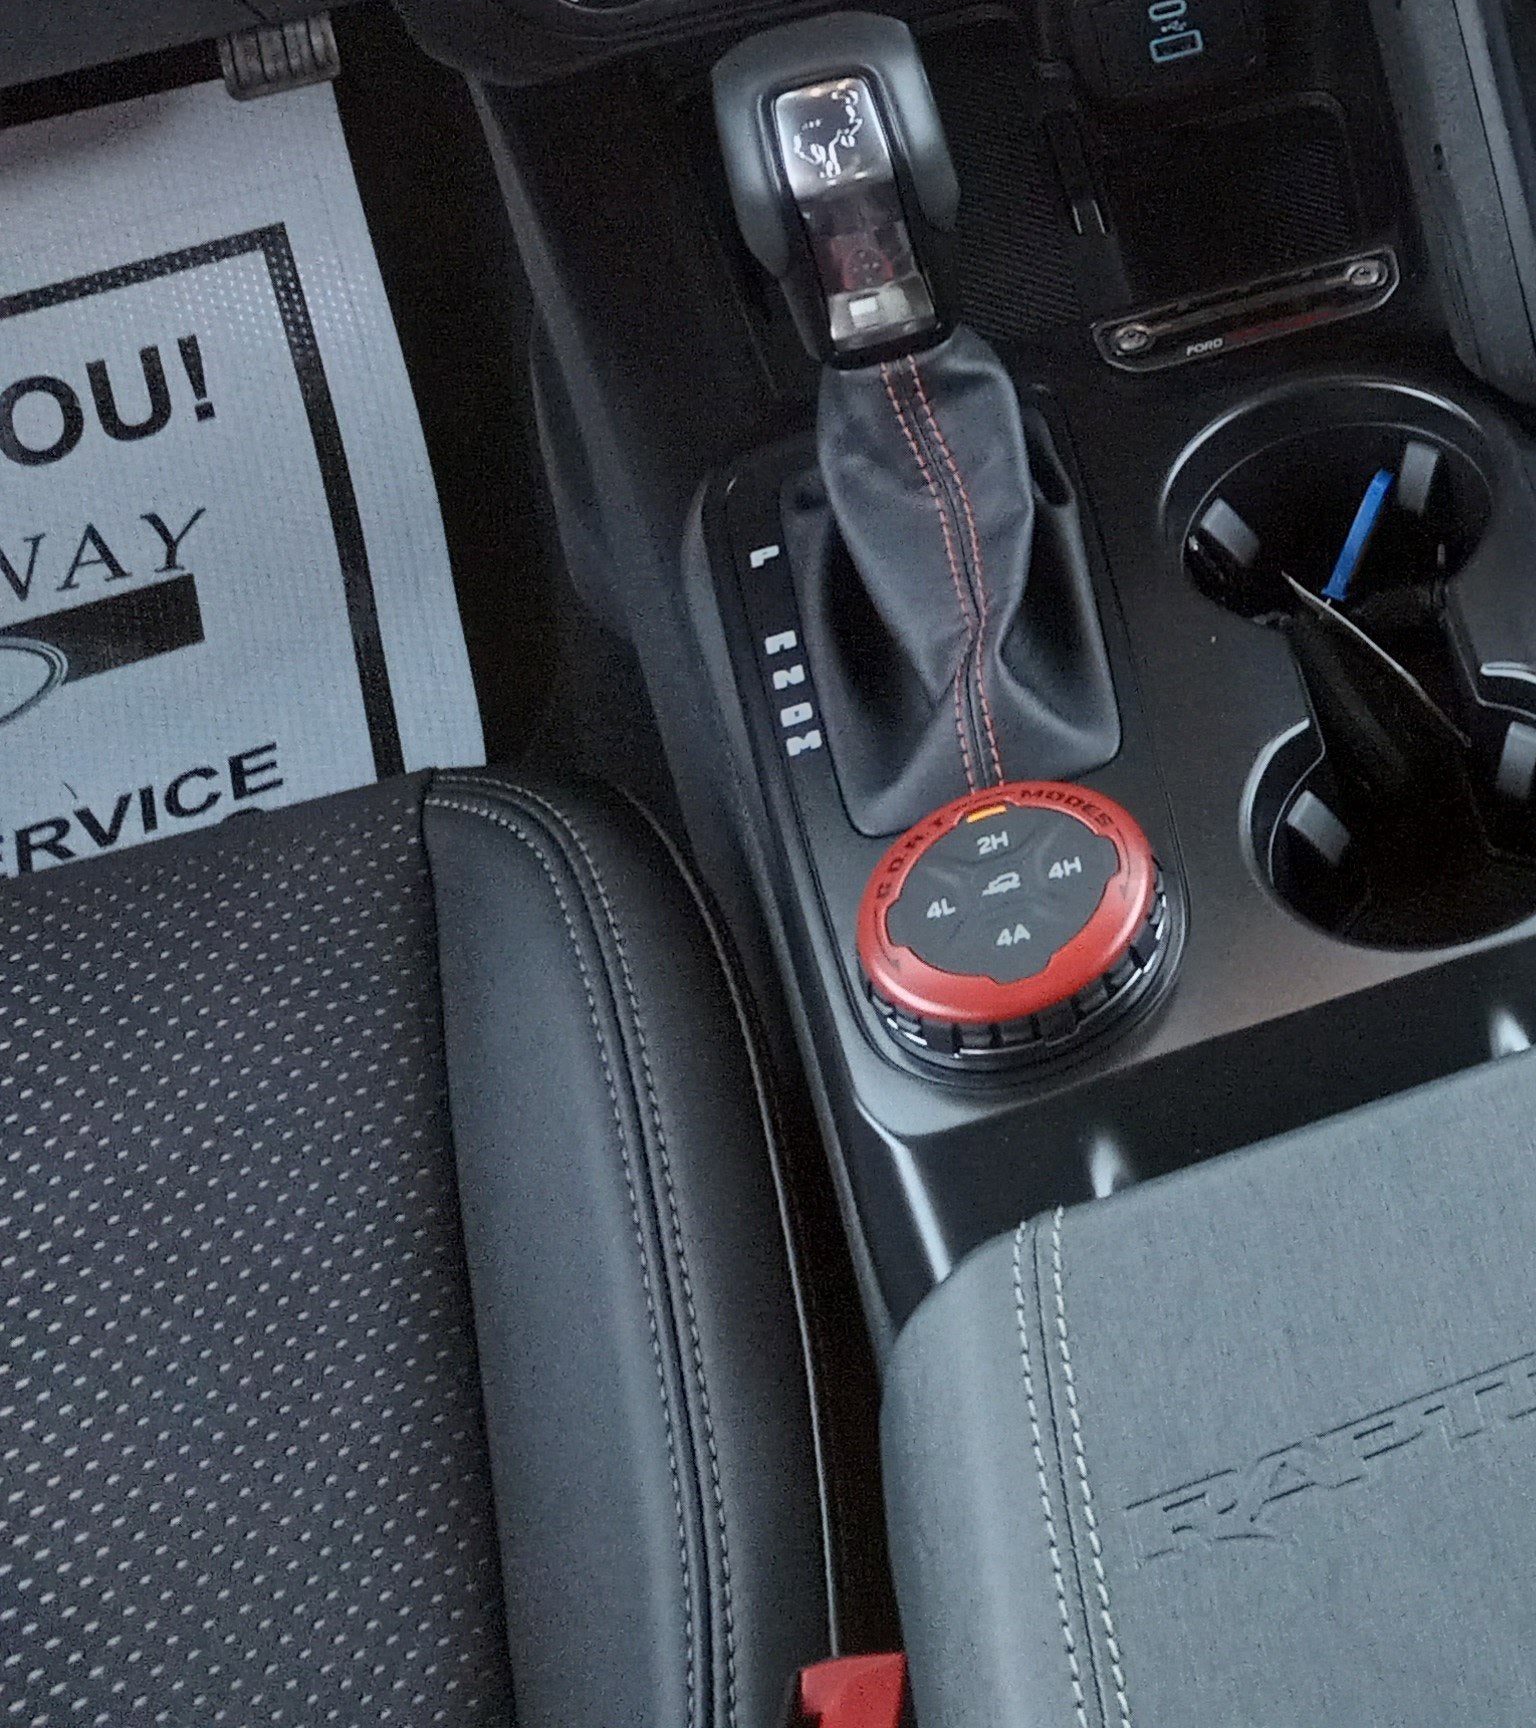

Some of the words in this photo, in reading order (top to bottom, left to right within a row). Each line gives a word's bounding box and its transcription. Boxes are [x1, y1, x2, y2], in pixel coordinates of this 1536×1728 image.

[1185, 336, 1224, 357] FORD
[749, 543, 780, 569] P
[772, 663, 806, 691] N
[780, 701, 814, 728] D
[786, 728, 823, 757] M
[0, 741, 284, 878] RVICE
[1020, 787, 1114, 826] MODES
[976, 830, 1009, 856] 2H
[1047, 855, 1082, 880] 4H
[926, 897, 956, 920] 4L
[995, 923, 1031, 947] 4A
